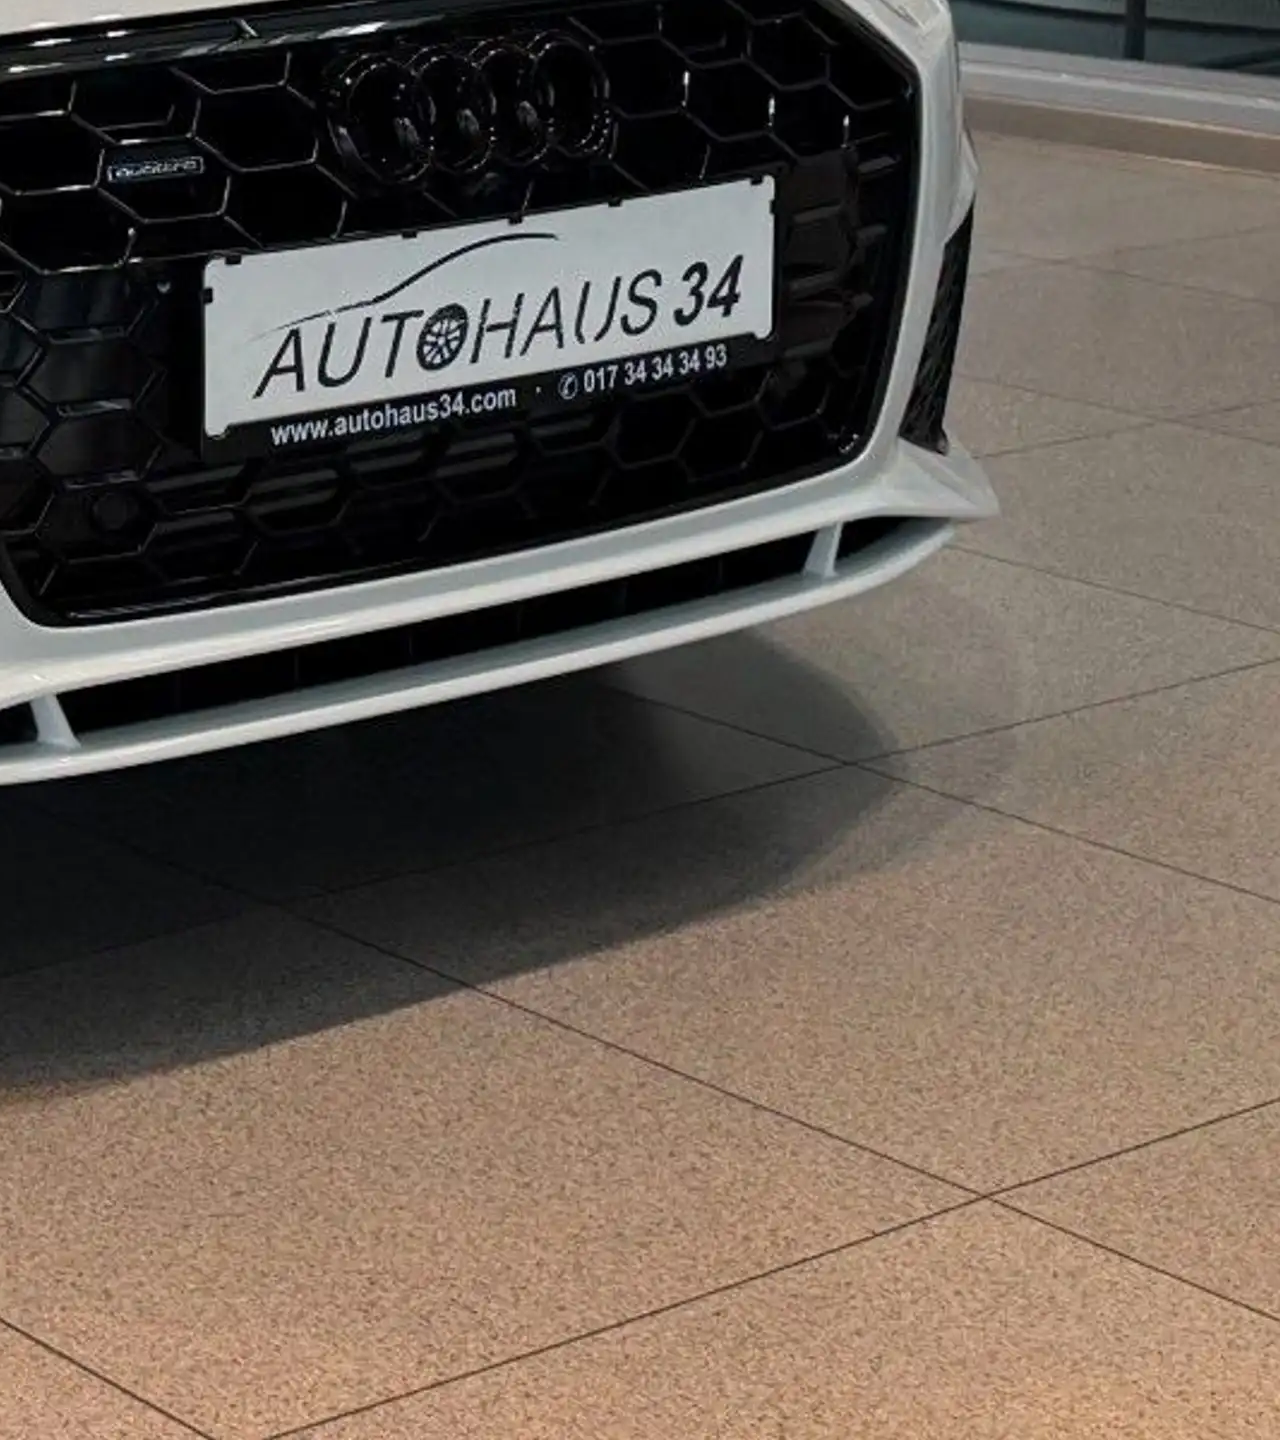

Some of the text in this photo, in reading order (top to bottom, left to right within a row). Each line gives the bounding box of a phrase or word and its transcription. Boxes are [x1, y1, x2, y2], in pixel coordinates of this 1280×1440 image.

[252, 254, 745, 400] AUTOHAUS 34
[270, 343, 728, 447] www.autohaus34.com 017 34 34 34 93
